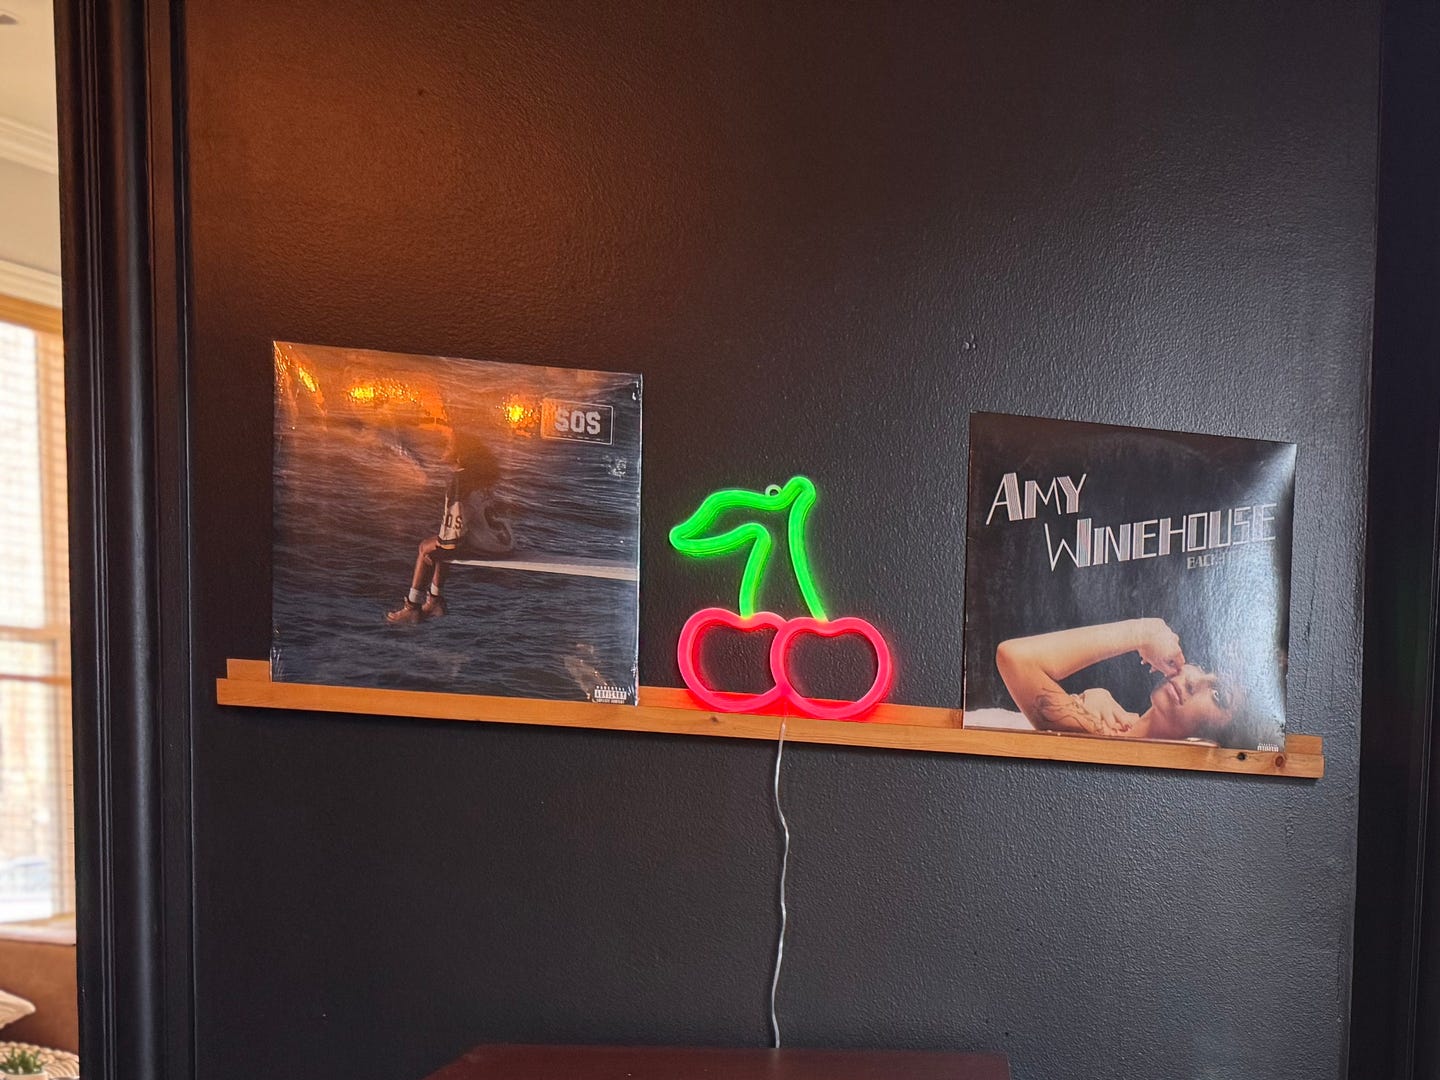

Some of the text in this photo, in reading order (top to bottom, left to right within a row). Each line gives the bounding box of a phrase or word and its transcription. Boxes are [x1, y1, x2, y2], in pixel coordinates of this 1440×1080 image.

[554, 407, 601, 435] SOS
[985, 472, 1087, 525] AMY
[1043, 503, 1278, 572] WINEHOUSE
